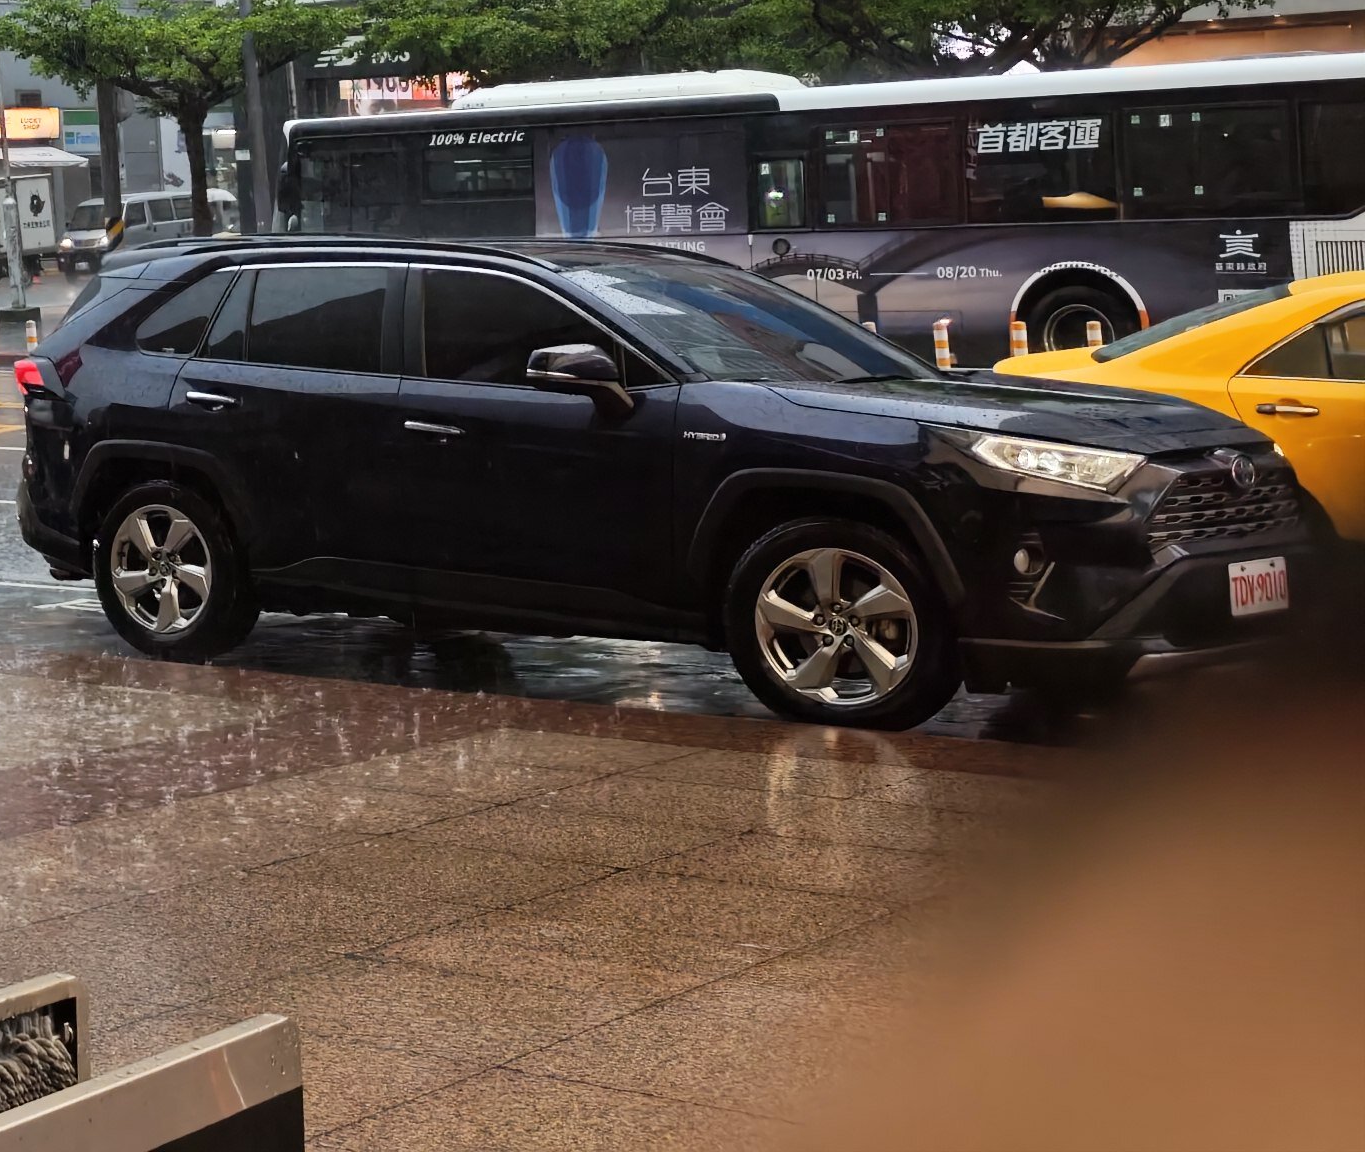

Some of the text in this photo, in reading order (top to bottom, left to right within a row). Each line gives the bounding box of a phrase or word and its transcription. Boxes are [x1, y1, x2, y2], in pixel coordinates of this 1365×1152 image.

[429, 130, 525, 146] 100% Electric
[977, 118, 1102, 154] 首都客運
[640, 165, 711, 197] 台東
[624, 200, 731, 234] 博覽會
[807, 265, 1003, 281] 07/03 Fri. 08/20 Thu.
[1231, 570, 1286, 608] TDV-9010
